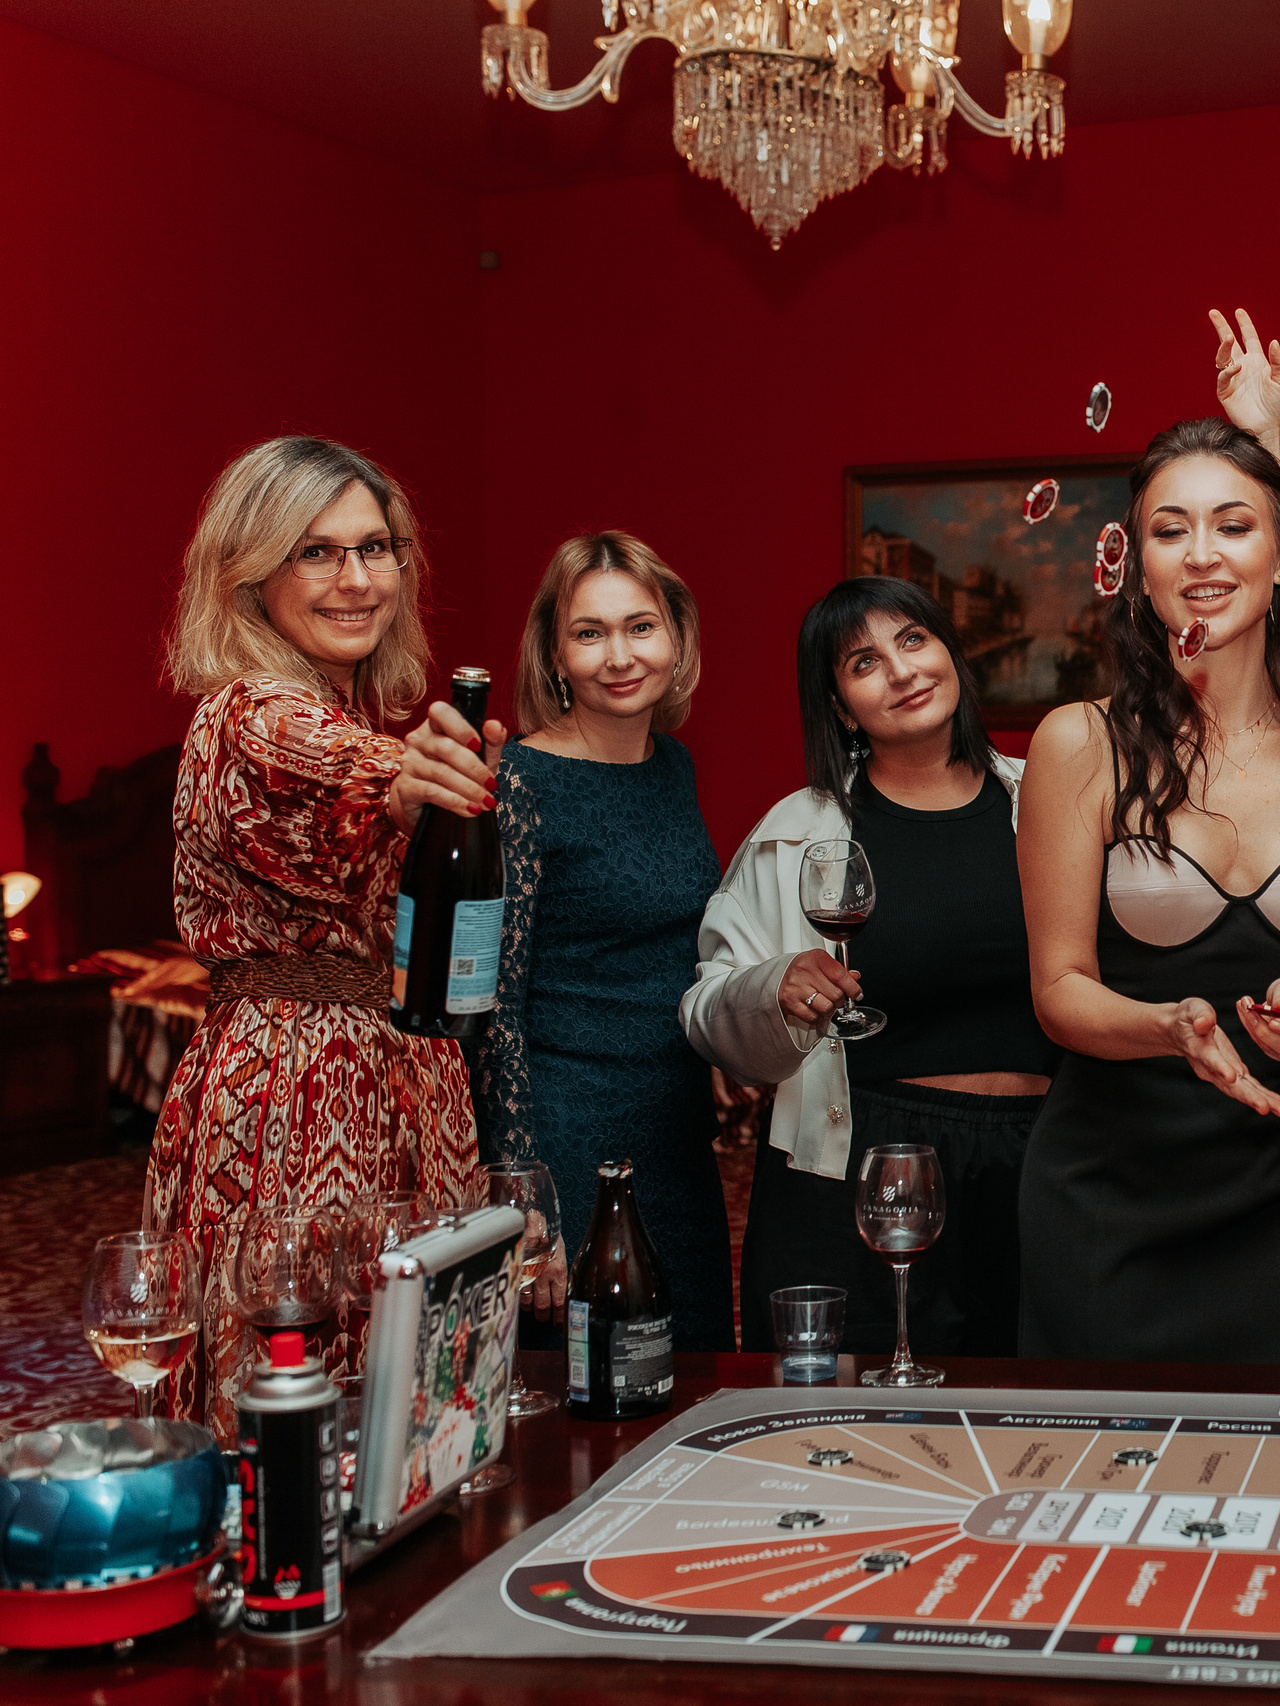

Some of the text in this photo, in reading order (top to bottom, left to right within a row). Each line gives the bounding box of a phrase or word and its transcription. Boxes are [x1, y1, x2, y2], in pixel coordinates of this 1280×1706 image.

[427, 1271, 509, 1345] POKER
[769, 1412, 867, 1427] Зеландия
[998, 1414, 1101, 1428] Австралия
[1207, 1421, 1273, 1433] Россия
[760, 1478, 810, 1493] GSM
[675, 1539, 832, 1574] Темпранильо
[563, 1598, 688, 1633] Португалия
[892, 1628, 1010, 1650] Франция
[1164, 1639, 1260, 1660] Италия
[1166, 1664, 1240, 1686] СВЕТ
